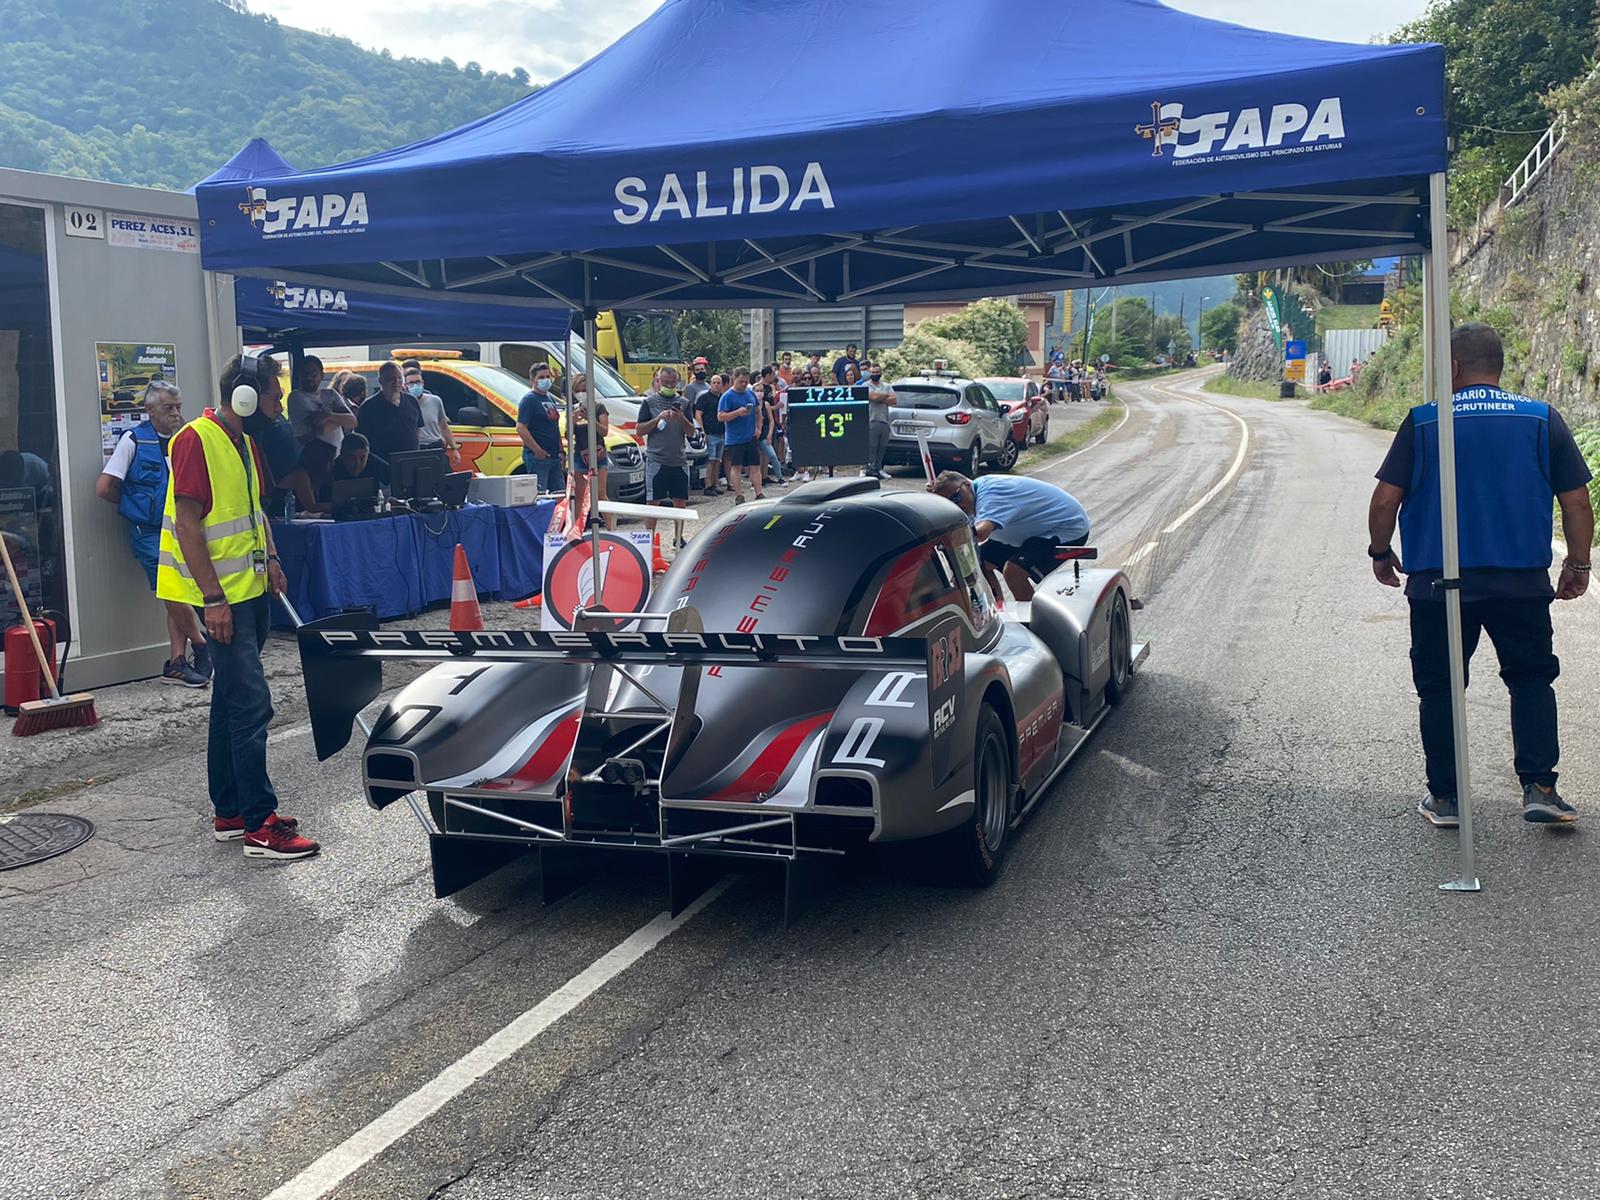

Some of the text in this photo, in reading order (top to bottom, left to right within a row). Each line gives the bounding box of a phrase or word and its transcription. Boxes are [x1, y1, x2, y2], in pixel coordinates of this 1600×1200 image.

[1174, 97, 1345, 157] FAPA
[1172, 157, 1206, 166] FEDERACIÓN
[1215, 152, 1259, 161] AUTOMOVILISMO
[1271, 147, 1304, 156] PRINCIPADO
[1314, 142, 1342, 151] ASTURIAS
[613, 161, 835, 225] SALIDA
[70, 211, 97, 231] 02
[262, 191, 368, 233] FAPA
[111, 219, 146, 232] PEREZ
[284, 287, 348, 310] FAPA
[805, 387, 854, 402] 17:21
[1430, 389, 1532, 407] CISARIO TECNICO
[763, 514, 783, 530] 1
[320, 631, 884, 653] PREMIERAUTO
